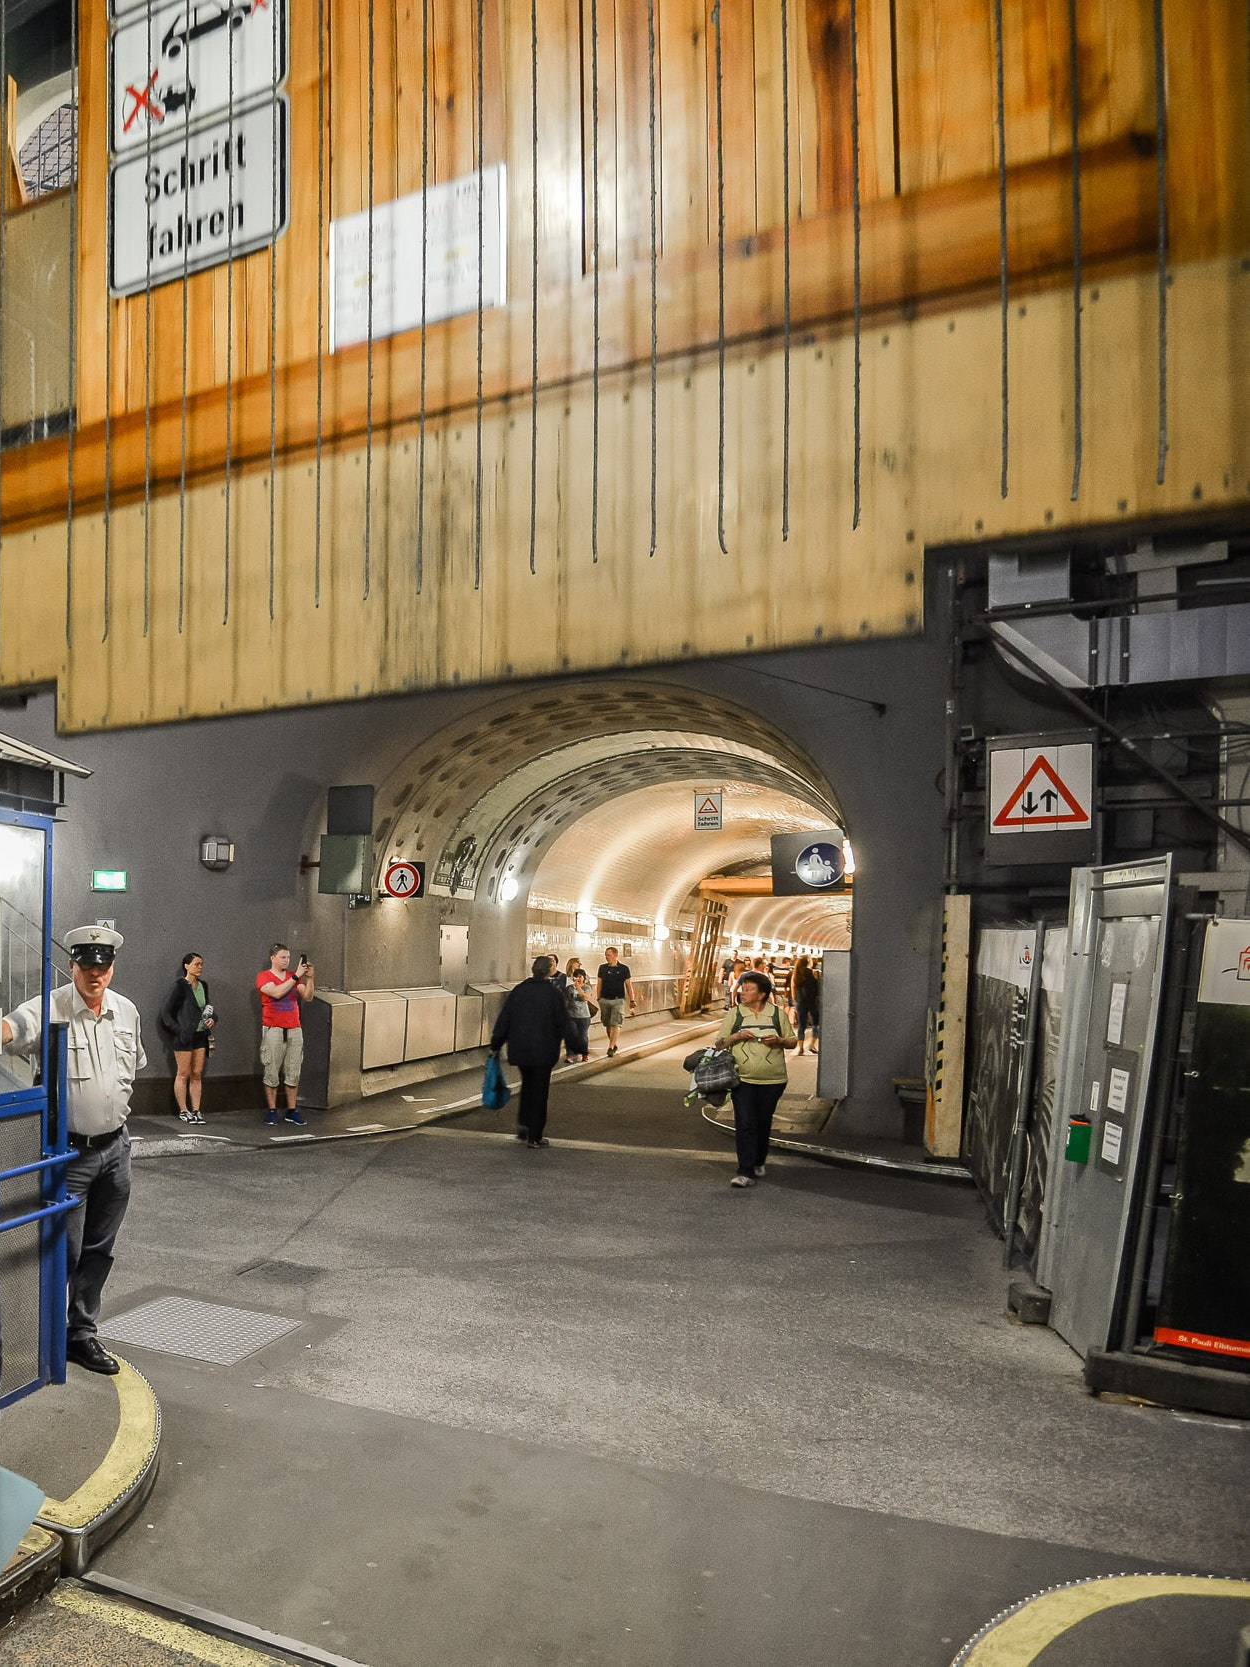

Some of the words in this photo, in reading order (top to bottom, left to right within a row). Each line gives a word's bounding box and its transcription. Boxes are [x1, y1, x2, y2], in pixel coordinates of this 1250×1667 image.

[145, 132, 246, 205] Schritt
[147, 201, 244, 261] fahren
[1178, 1335, 1189, 1343] St.
[1191, 1337, 1212, 1347] Pauli
